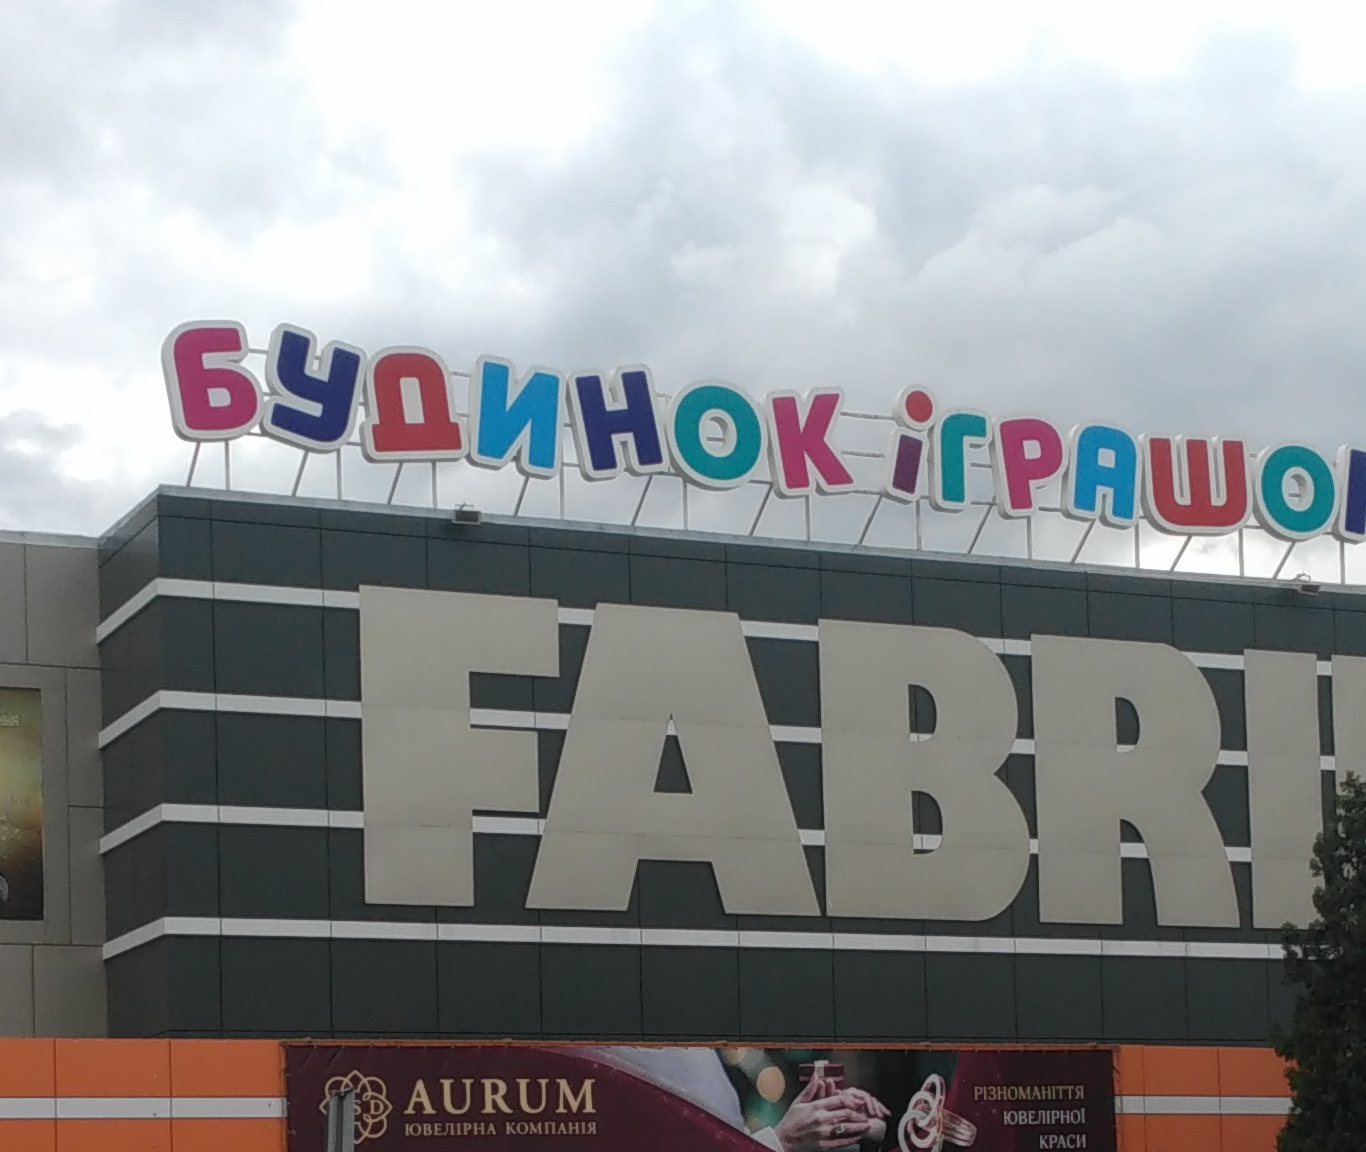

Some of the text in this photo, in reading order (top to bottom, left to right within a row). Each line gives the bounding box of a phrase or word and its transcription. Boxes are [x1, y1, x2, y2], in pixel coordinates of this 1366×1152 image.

[162, 320, 859, 500] БУДИНОК
[403, 1078, 597, 1114] AURUM
[974, 1085, 1084, 1101] РІЗНОМАНІТТЯ
[1003, 1108, 1085, 1126] ЮВЕЛІРНОЇ
[404, 1121, 598, 1137] ЮВЕЛІРНА КОМПАНІЯ
[1039, 1134, 1086, 1149] КРАСИ
